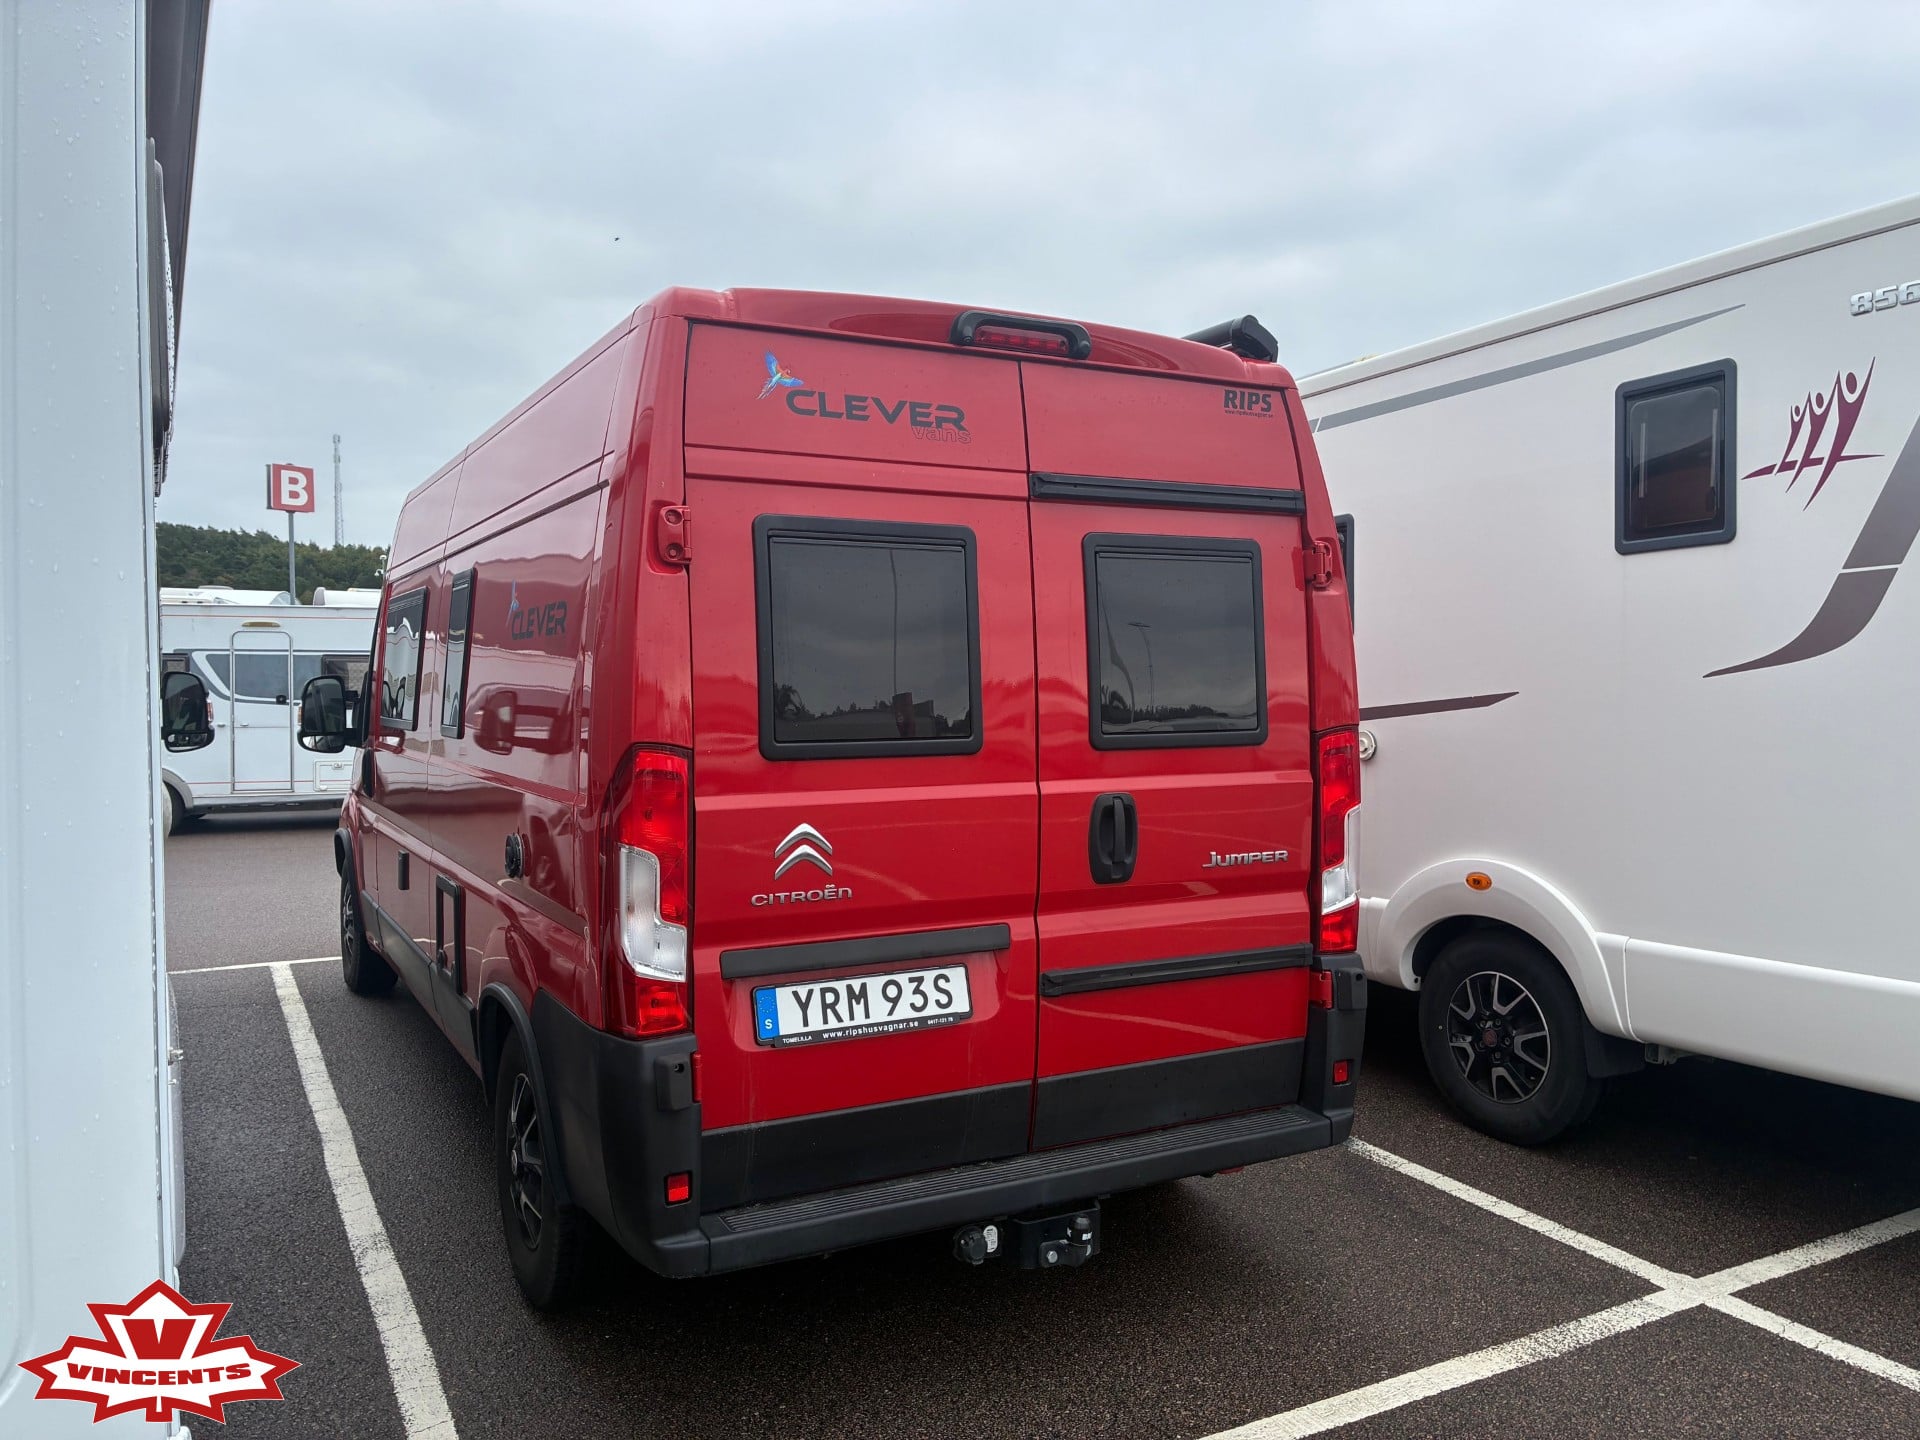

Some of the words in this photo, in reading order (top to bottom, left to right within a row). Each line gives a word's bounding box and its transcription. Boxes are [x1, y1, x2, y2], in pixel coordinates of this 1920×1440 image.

[1850, 280, 1920, 317] 856
[785, 389, 968, 432] CLEVER
[1223, 389, 1272, 413] RIPS
[911, 425, 972, 444] vans
[280, 469, 309, 506] B
[511, 600, 568, 640] CLEVER
[1202, 850, 1289, 868] JUMPER
[791, 982, 871, 1028] YRM
[881, 973, 953, 1017] 93S
[764, 1019, 773, 1030] S
[822, 1020, 919, 1039] www.ripshusvagnar.se
